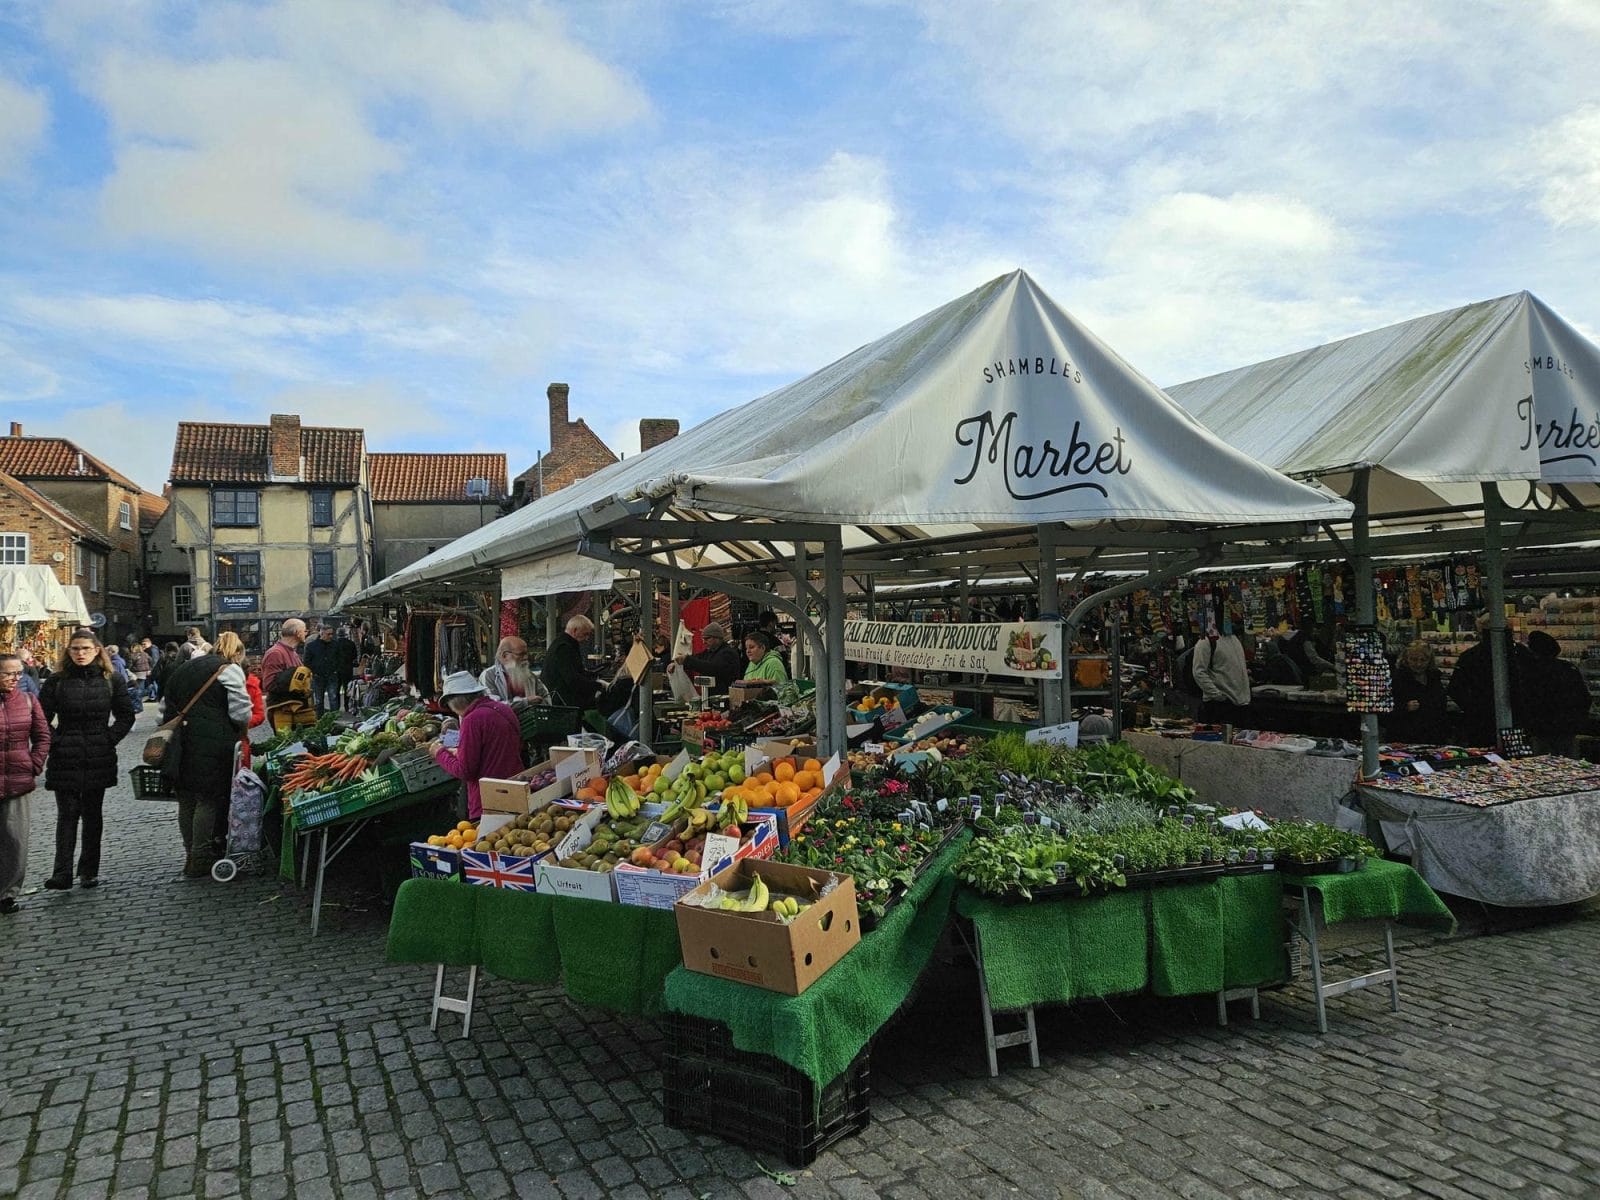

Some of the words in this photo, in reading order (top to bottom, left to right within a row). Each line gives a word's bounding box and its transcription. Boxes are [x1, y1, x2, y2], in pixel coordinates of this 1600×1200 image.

[983, 357, 1081, 383] SHAMBLES
[954, 410, 1132, 500] Market
[861, 622, 898, 646] HOME
[896, 624, 944, 649] GROWN
[940, 625, 1001, 651] PRODUCE
[866, 648, 883, 660] Fruit
[885, 650, 891, 661] &
[894, 650, 936, 666] Vegetables
[942, 654, 956, 668] Fri
[959, 655, 966, 667] &
